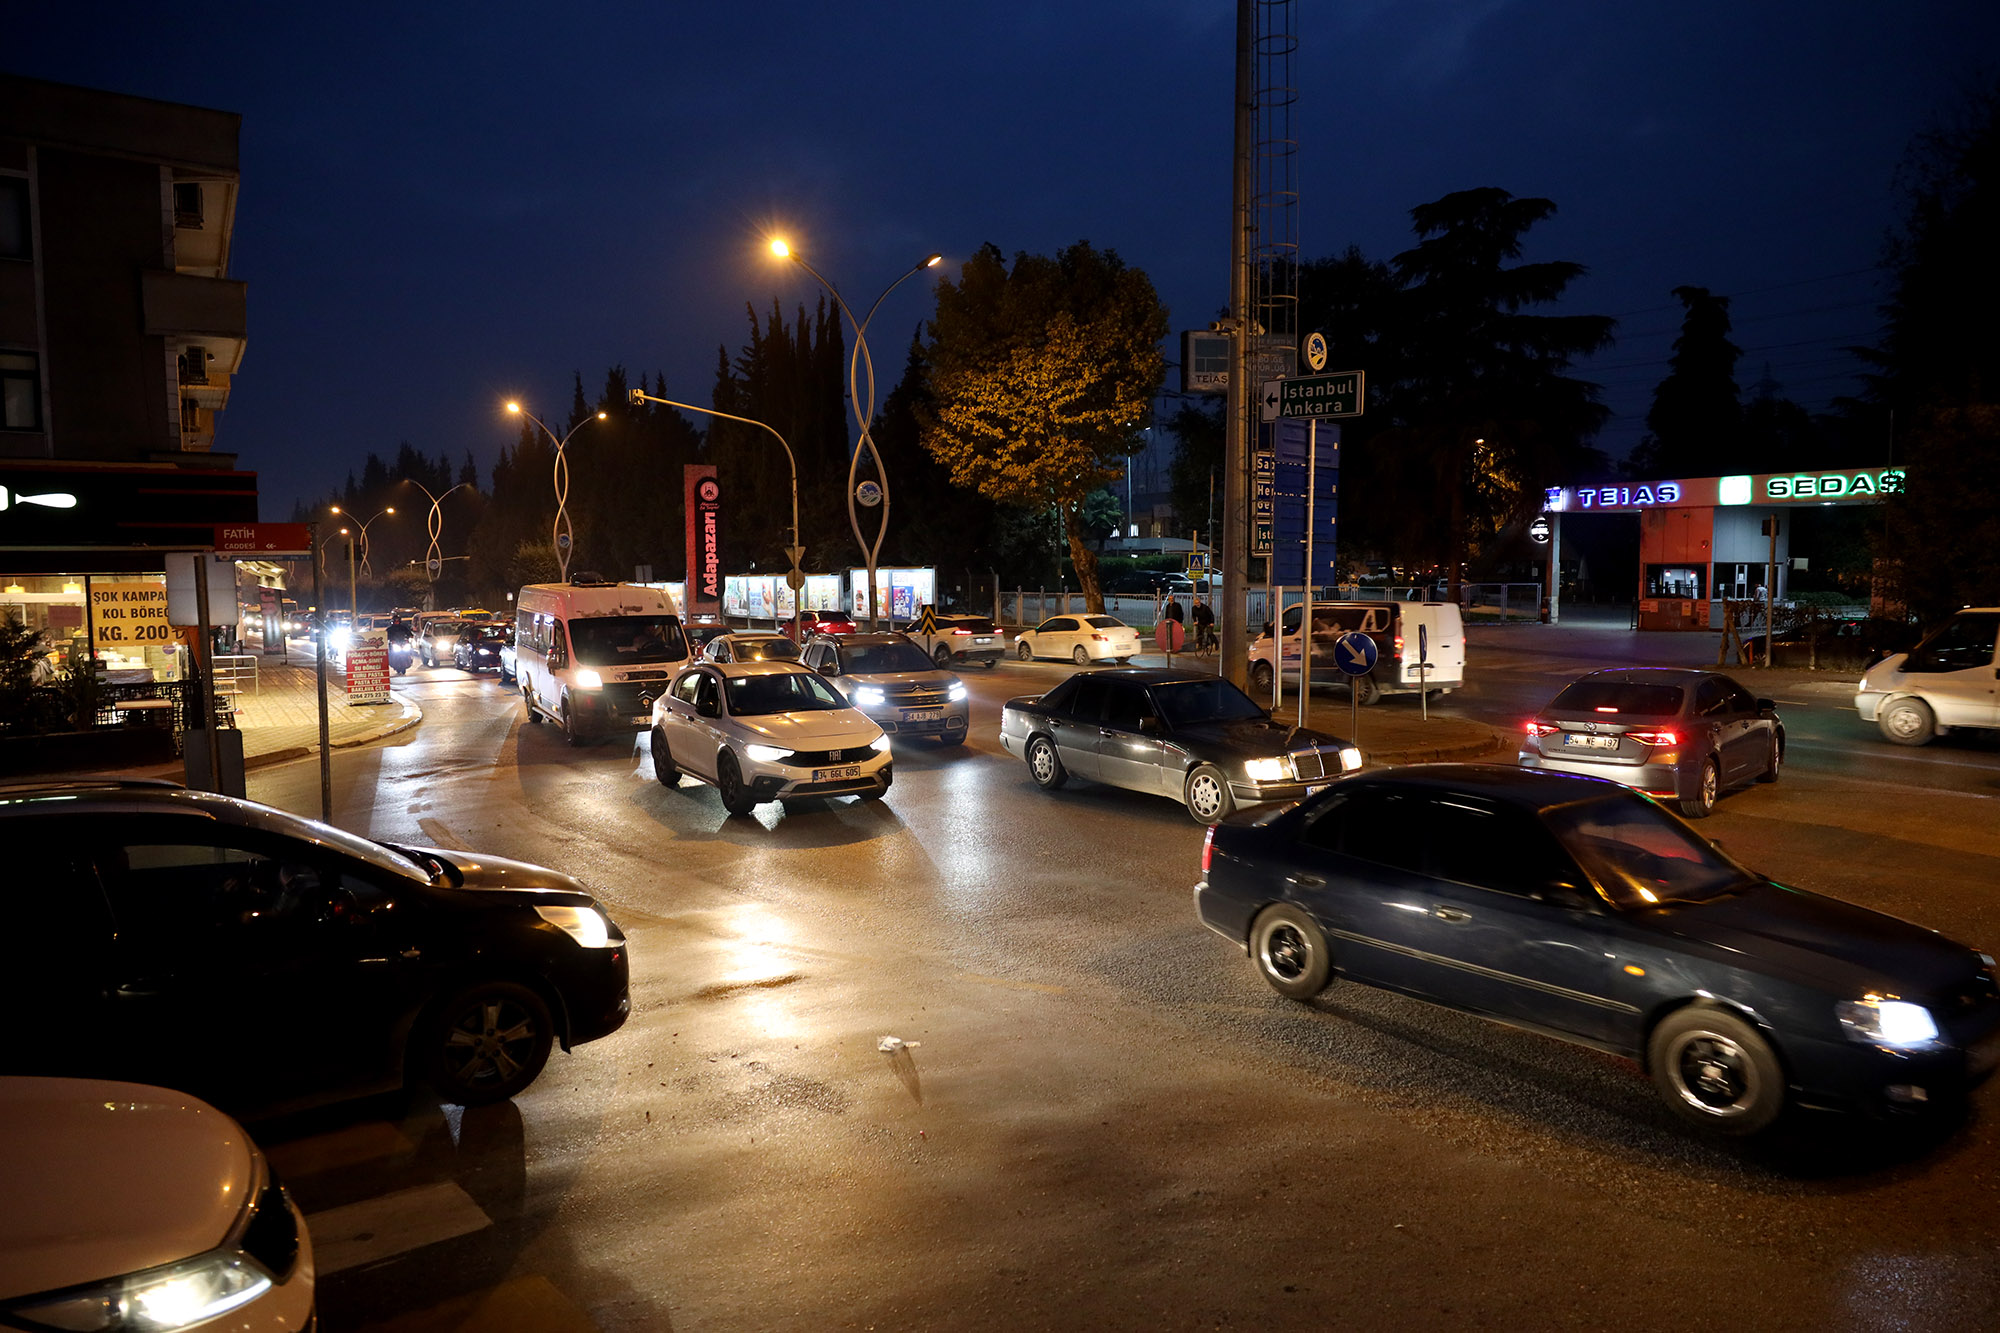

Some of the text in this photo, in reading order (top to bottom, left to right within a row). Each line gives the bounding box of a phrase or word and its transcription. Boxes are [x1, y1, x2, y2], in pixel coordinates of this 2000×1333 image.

[1196, 373, 1228, 384] TEİAŞ
[1284, 379, 1353, 399] İstanbul
[1282, 401, 1342, 416] Ankara
[223, 527, 255, 539] FATİH
[703, 511, 719, 597] Adapazarı
[93, 591, 168, 605] ŞOK KAMPA
[102, 608, 127, 619] KOL
[98, 626, 128, 641] KG.
[135, 625, 169, 640] 200
[1570, 735, 1618, 747] 54 NE 197
[829, 750, 842, 761] FIAT
[818, 771, 827, 780] 34
[845, 767, 858, 777] 605
